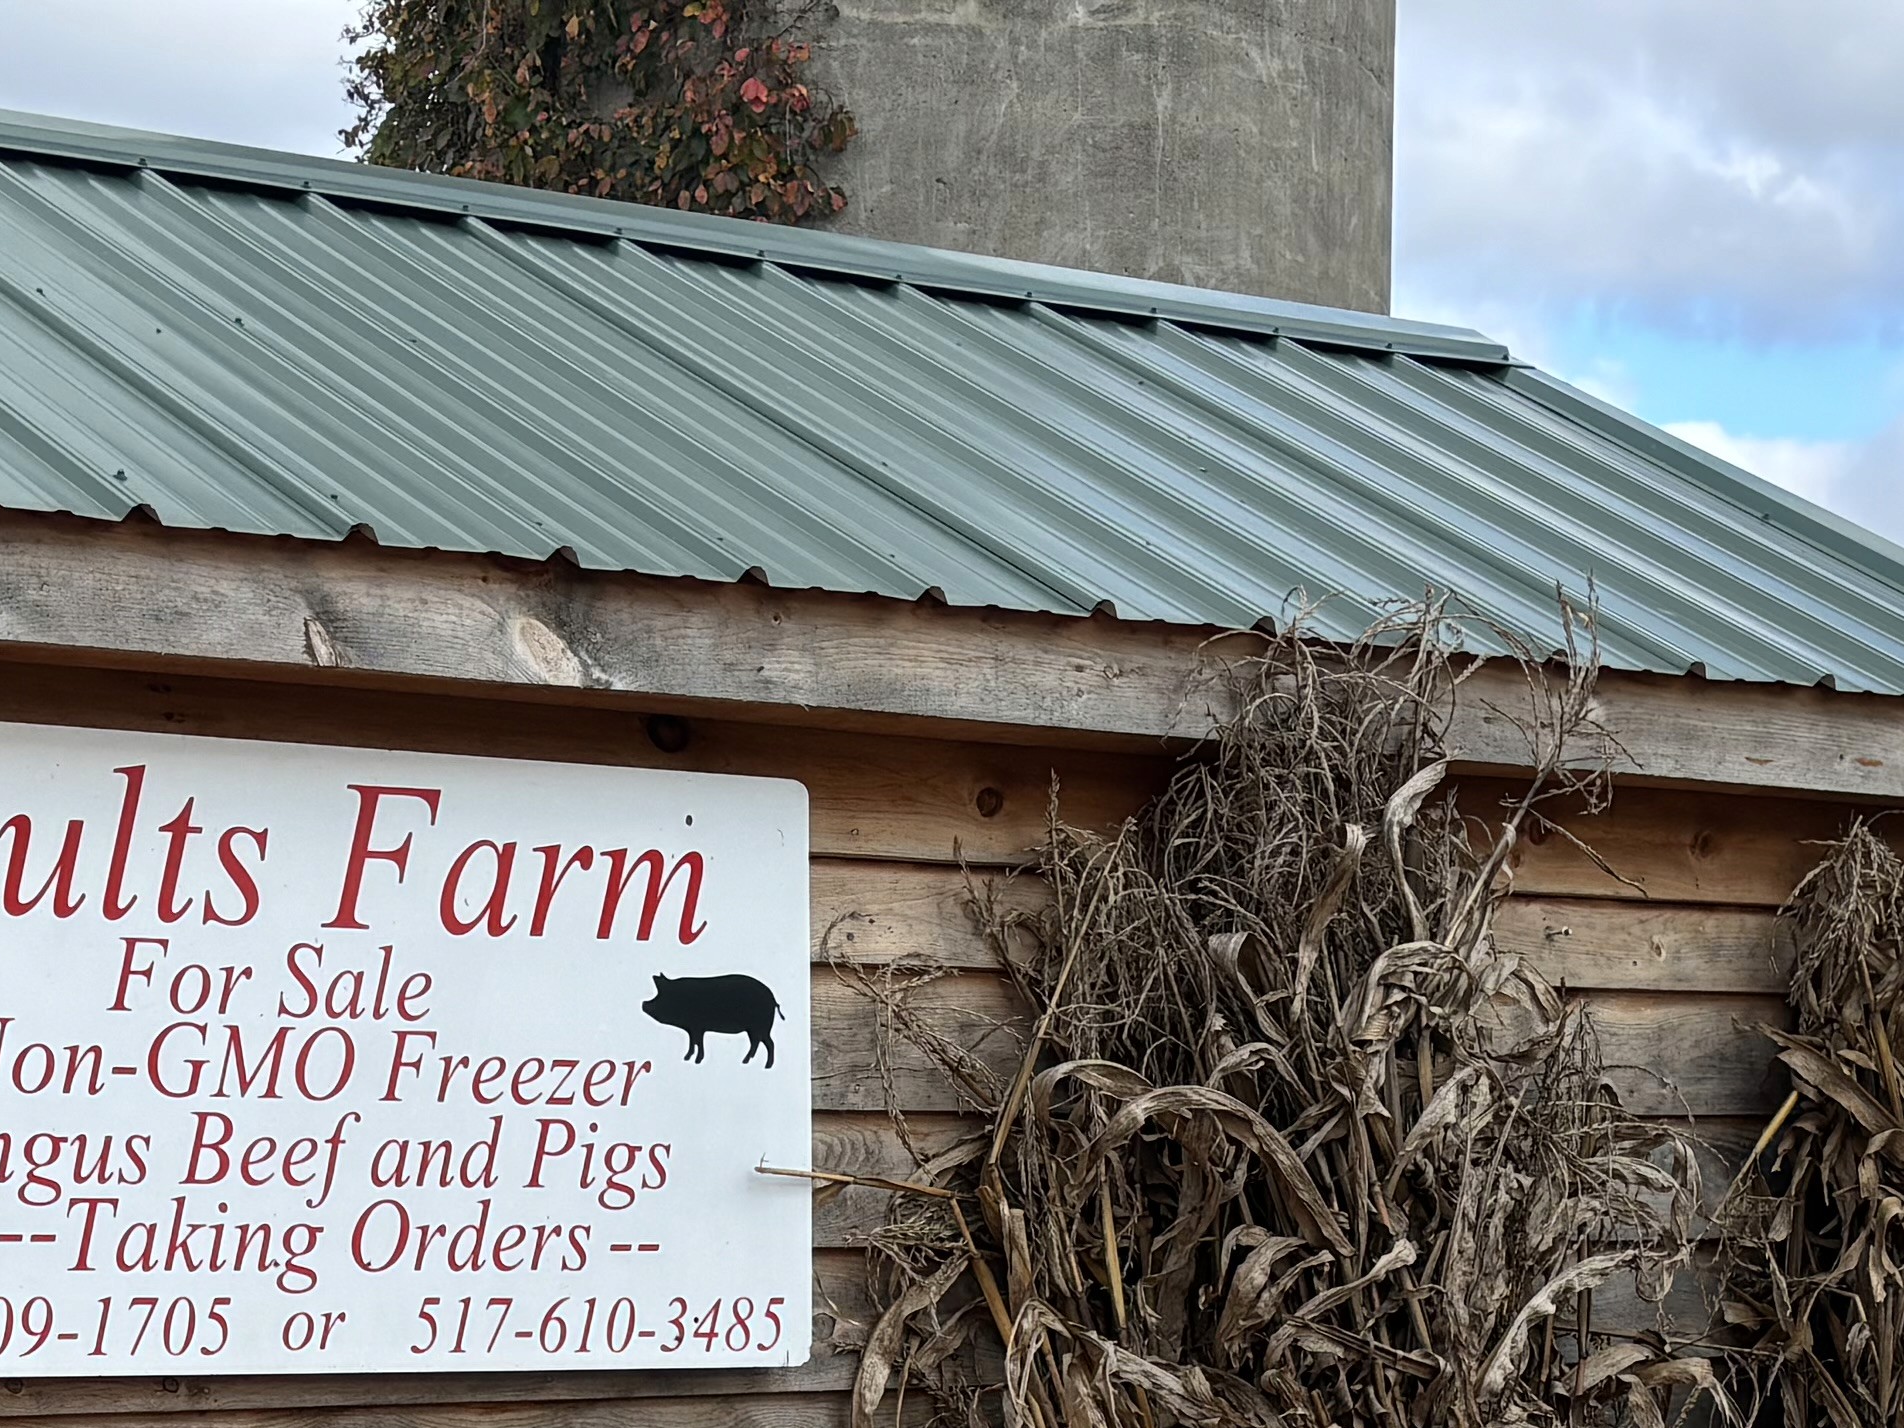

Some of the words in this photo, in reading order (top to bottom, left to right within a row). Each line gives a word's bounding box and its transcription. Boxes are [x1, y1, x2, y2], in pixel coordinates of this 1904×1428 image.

[321, 784, 708, 946] Farm
[107, 937, 252, 1015] For
[278, 943, 433, 1022] Sale
[379, 1030, 653, 1109] Freezer
[181, 1112, 360, 1212] Beef
[369, 1115, 504, 1190] and
[524, 1118, 672, 1211] Pigs
[350, 1199, 592, 1273] Orders
[280, 1312, 348, 1353] or
[410, 1296, 786, 1355] 517-610-3485
